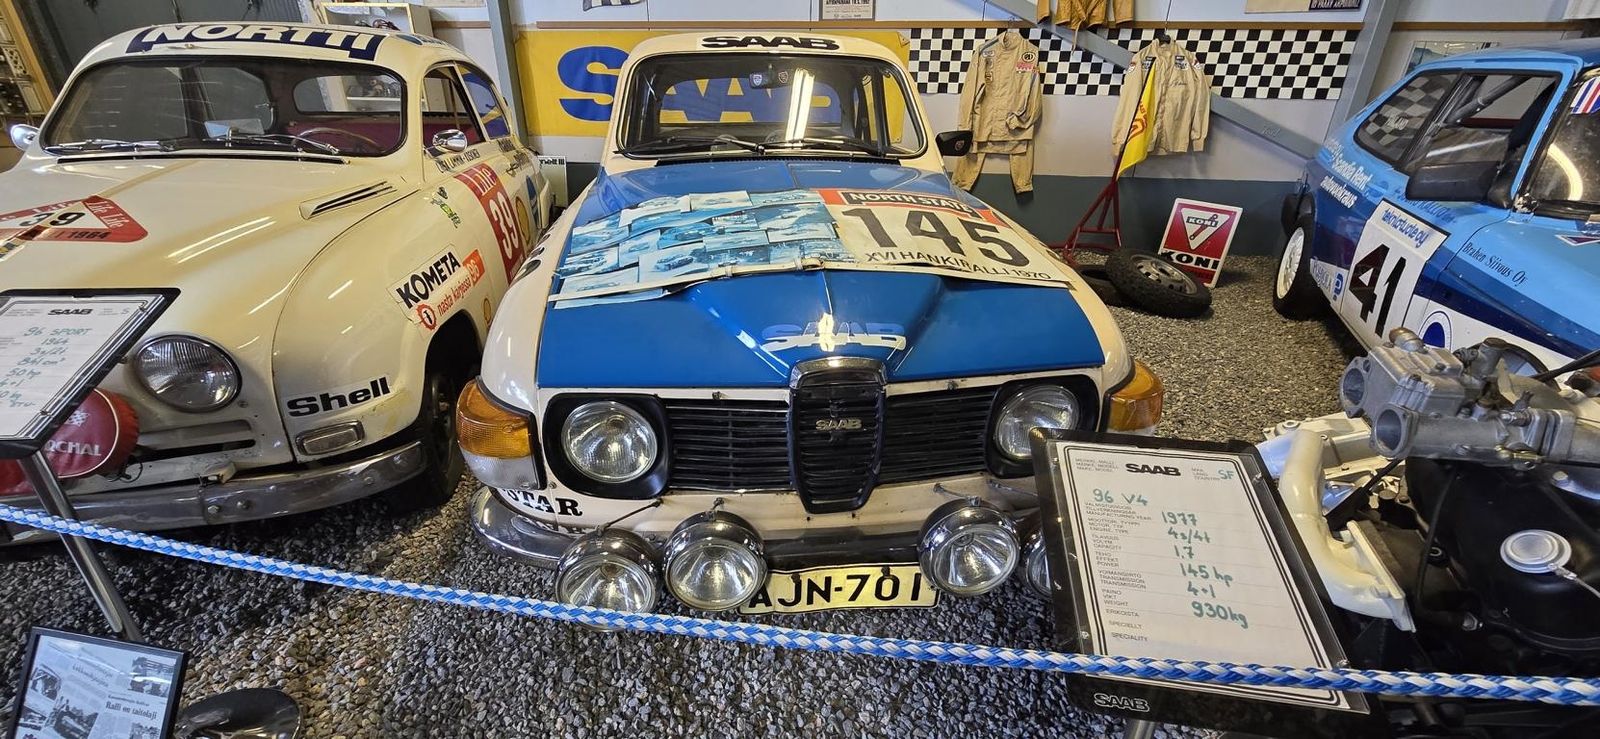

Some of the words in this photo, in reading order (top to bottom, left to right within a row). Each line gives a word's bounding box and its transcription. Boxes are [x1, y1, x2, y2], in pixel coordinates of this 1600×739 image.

[142, 24, 383, 52] NORTTI
[701, 36, 840, 50] SAAB
[850, 193, 920, 208] NORTH
[919, 197, 974, 213] STATE
[20, 212, 85, 227] 39
[489, 191, 520, 260] 39
[1189, 217, 1217, 227] KONI
[842, 208, 1030, 267] 145
[865, 252, 898, 262] XVI
[902, 251, 1010, 276] HANKIRALLI
[1014, 270, 1052, 280] 1970
[1160, 251, 1220, 270] KONI
[396, 251, 461, 309] KOMETA
[1348, 243, 1407, 339] 41
[48, 308, 93, 316] SAAB
[50, 327, 93, 336] SPORT
[761, 321, 907, 351] SAAB
[287, 377, 390, 417] Shell
[815, 417, 863, 431] SAAB
[1125, 463, 1182, 477] SAAB
[1218, 469, 1235, 480] SF
[1092, 488, 1114, 503] 96
[1121, 493, 1148, 506] V4
[1161, 511, 1198, 526] 1977
[1174, 545, 1194, 559] 1.7
[1180, 562, 1210, 579] 145
[1212, 566, 1234, 588] hp
[748, 573, 922, 608] AJN-701
[1093, 692, 1150, 713] SAAB
